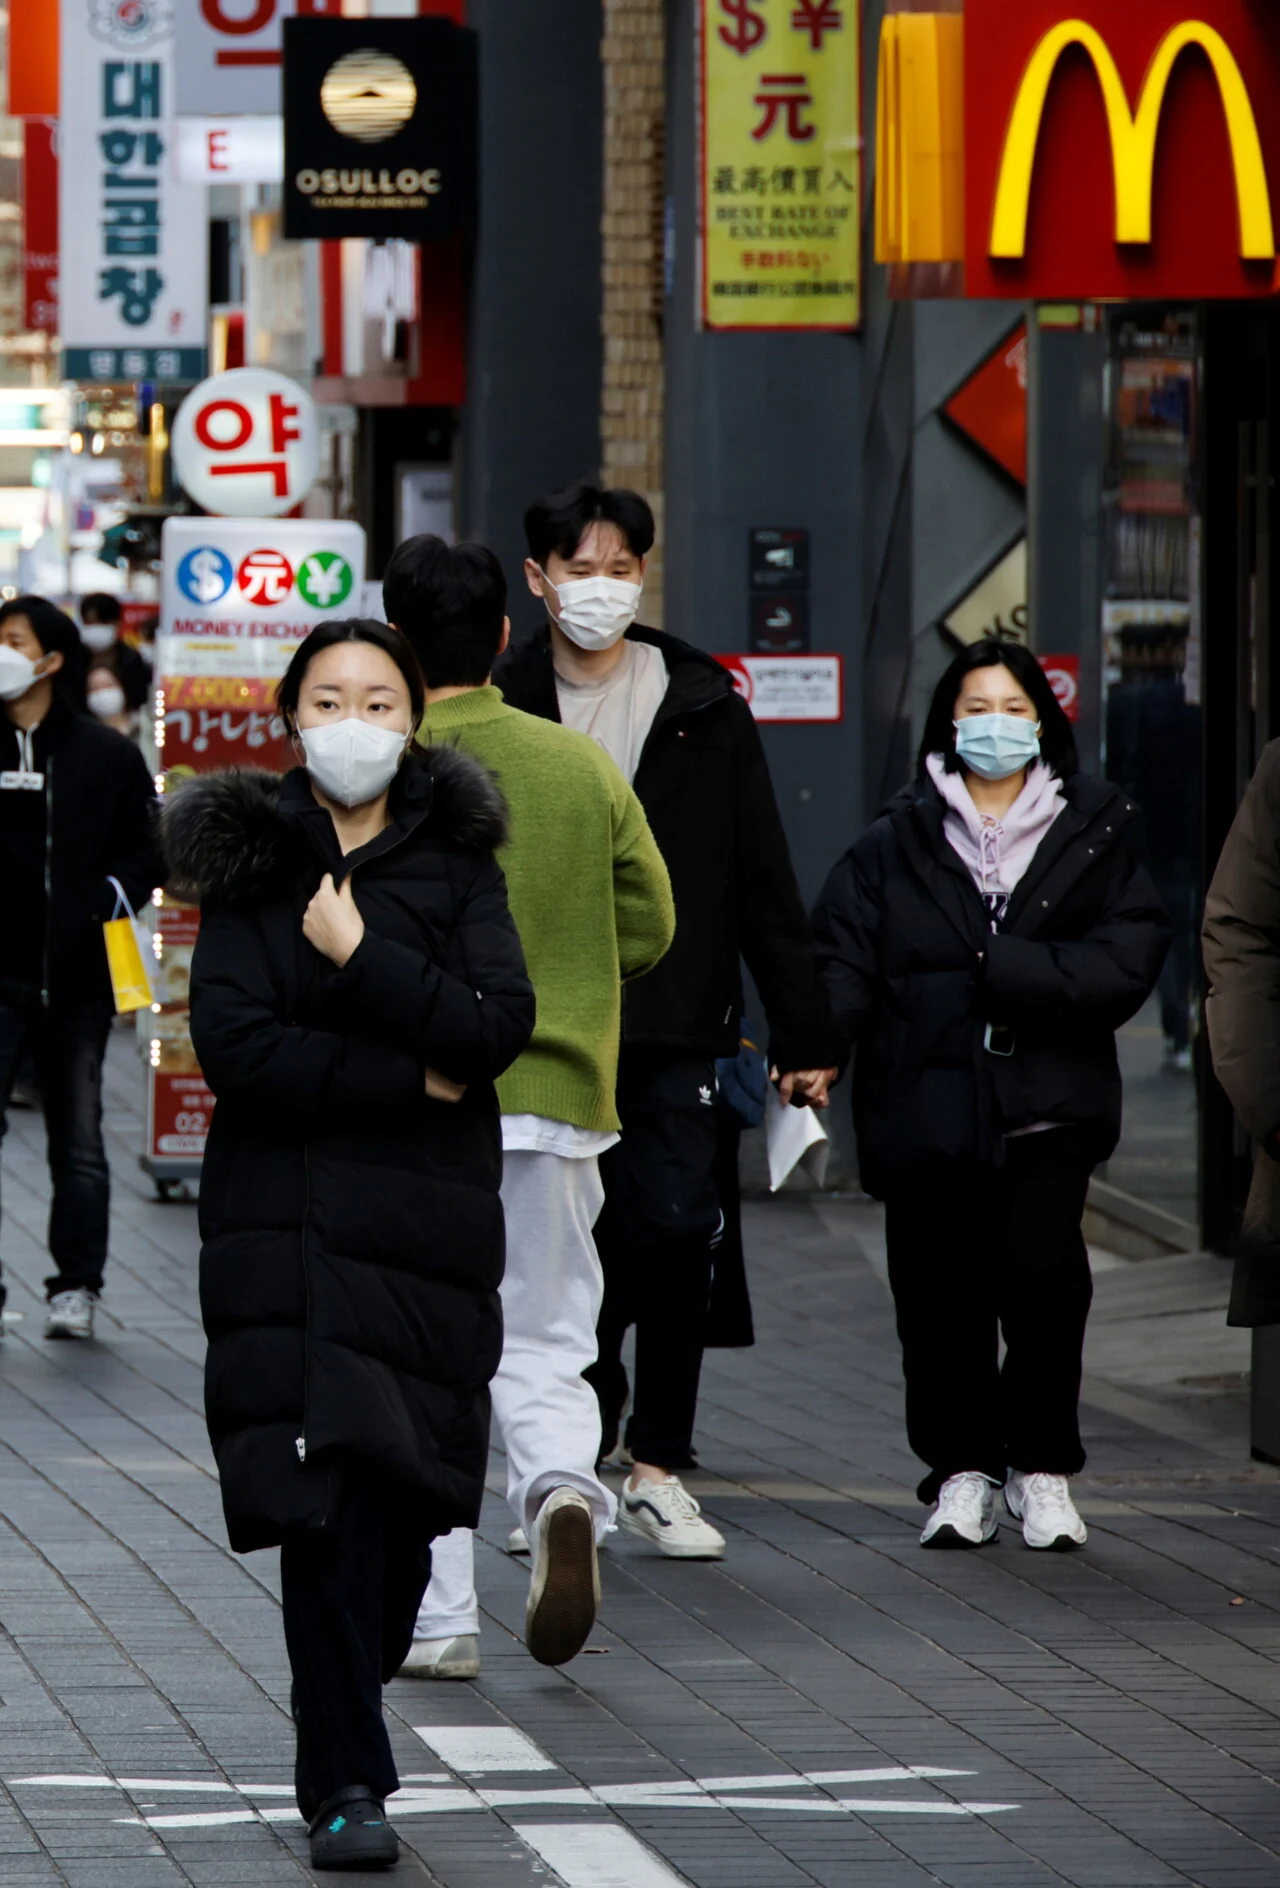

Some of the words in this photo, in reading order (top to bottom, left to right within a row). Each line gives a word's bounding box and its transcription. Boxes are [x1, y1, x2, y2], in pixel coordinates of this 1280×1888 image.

[751, 74, 816, 140] 元
[99, 61, 164, 326] 대한곱창
[294, 167, 442, 195] OSULLOC
[194, 393, 302, 497] 약
[187, 550, 225, 602] $
[240, 551, 289, 602] 元
[303, 556, 347, 607] ¥
[172, 618, 244, 637] MONEY
[247, 620, 316, 639] EXCHA
